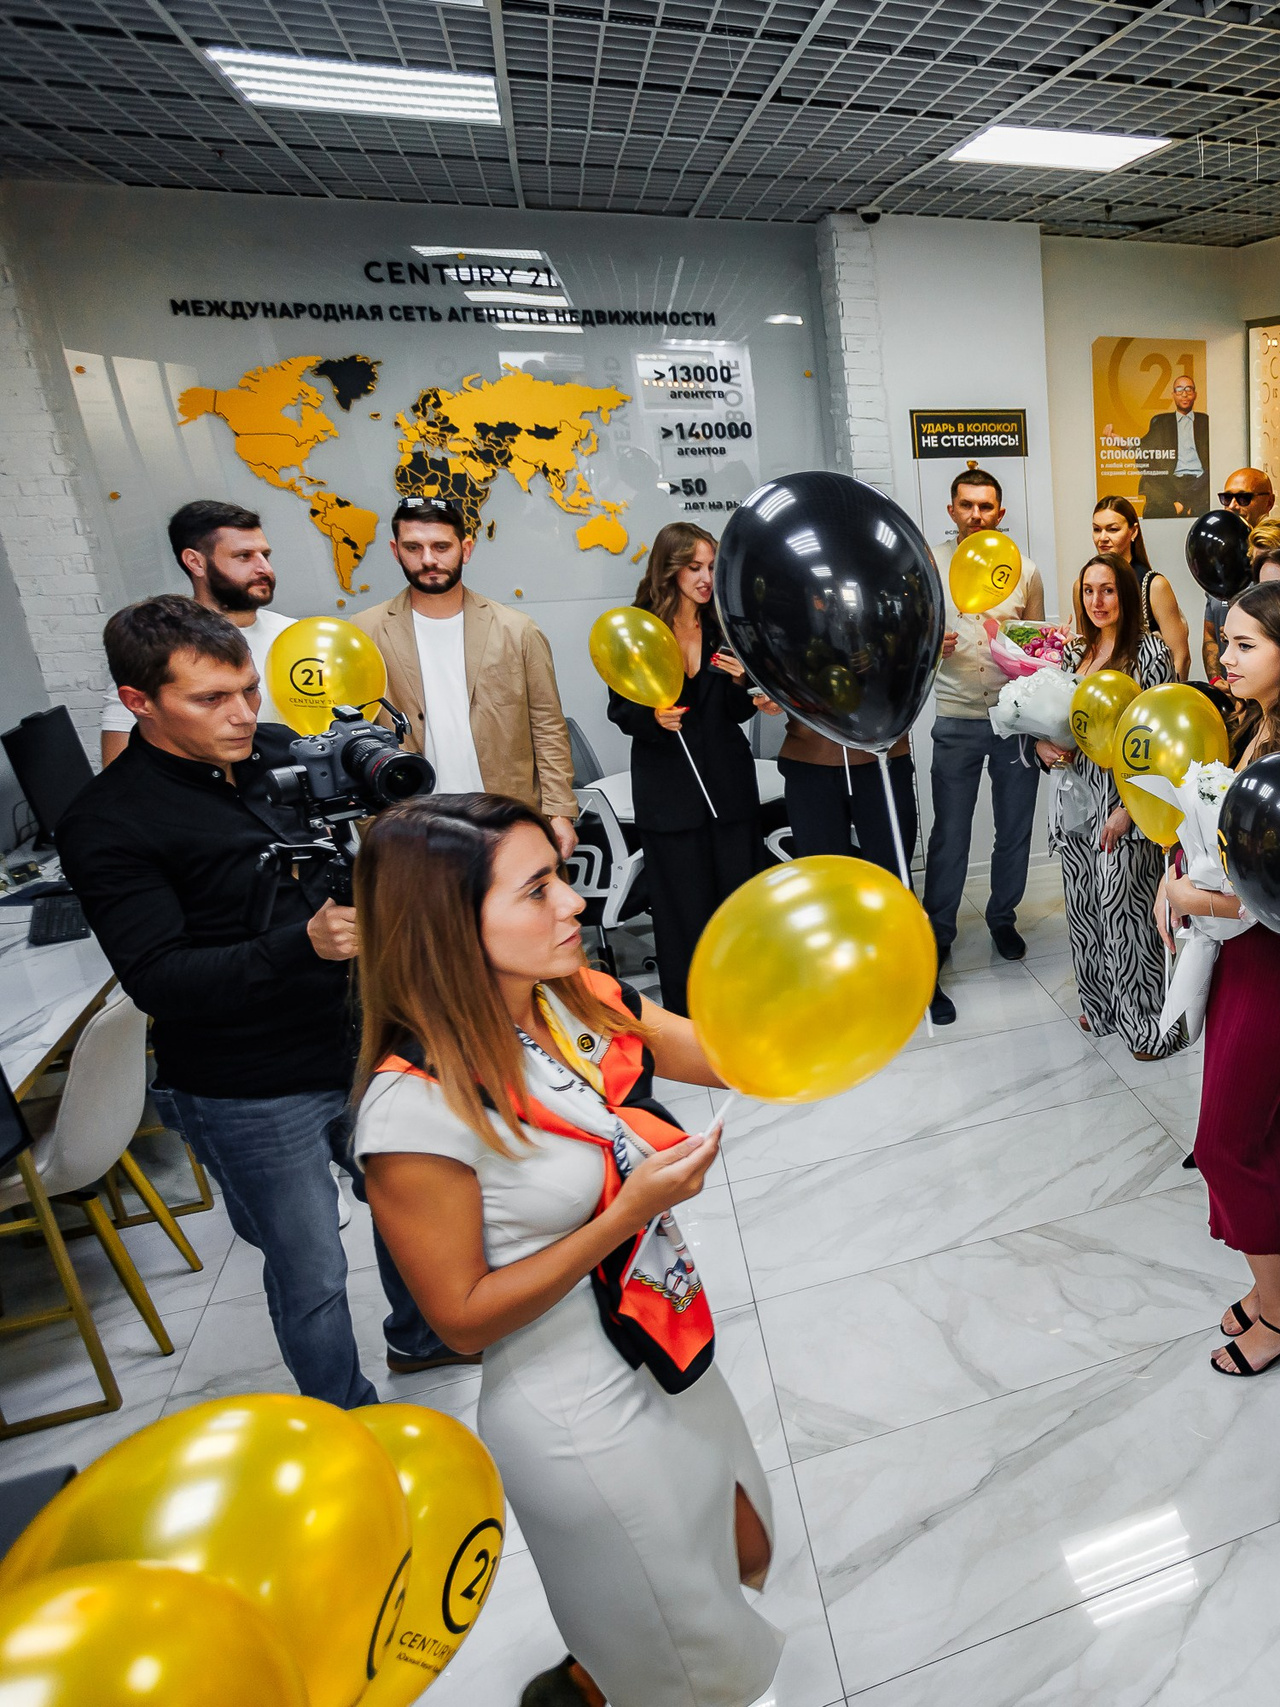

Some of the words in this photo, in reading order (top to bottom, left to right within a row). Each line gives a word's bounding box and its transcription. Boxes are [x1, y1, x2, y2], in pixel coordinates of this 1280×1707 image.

[364, 261, 516, 287] CENTURY
[527, 266, 554, 288] 21
[170, 299, 384, 323] МЕЖДУНАРОДНАЯ
[388, 305, 442, 322] СЕТЬ
[448, 306, 550, 324] АГЕНТСТВ
[555, 309, 716, 327] НЕДВИЖИМОСТИ
[653, 365, 732, 384] >13000
[669, 389, 725, 400] агентств
[661, 422, 752, 440] >140000
[921, 423, 955, 434] УДАРЬ
[957, 423, 965, 433] В
[966, 423, 1018, 432] КОЛОКОЛ
[921, 435, 939, 447] НЕ
[940, 434, 1019, 447] СТЕСНЯЯСЬ!
[1100, 436, 1141, 447] ТОЛЬКО
[677, 446, 726, 456] агентов
[1100, 447, 1176, 460] СПОКОЙСТВИЕ
[669, 478, 708, 496] >50
[684, 502, 705, 511] лет
[708, 501, 723, 510] на
[301, 668, 324, 686] 21
[289, 697, 326, 705] CENTURY
[1130, 738, 1151, 760] 21
[460, 1548, 498, 1606] 21
